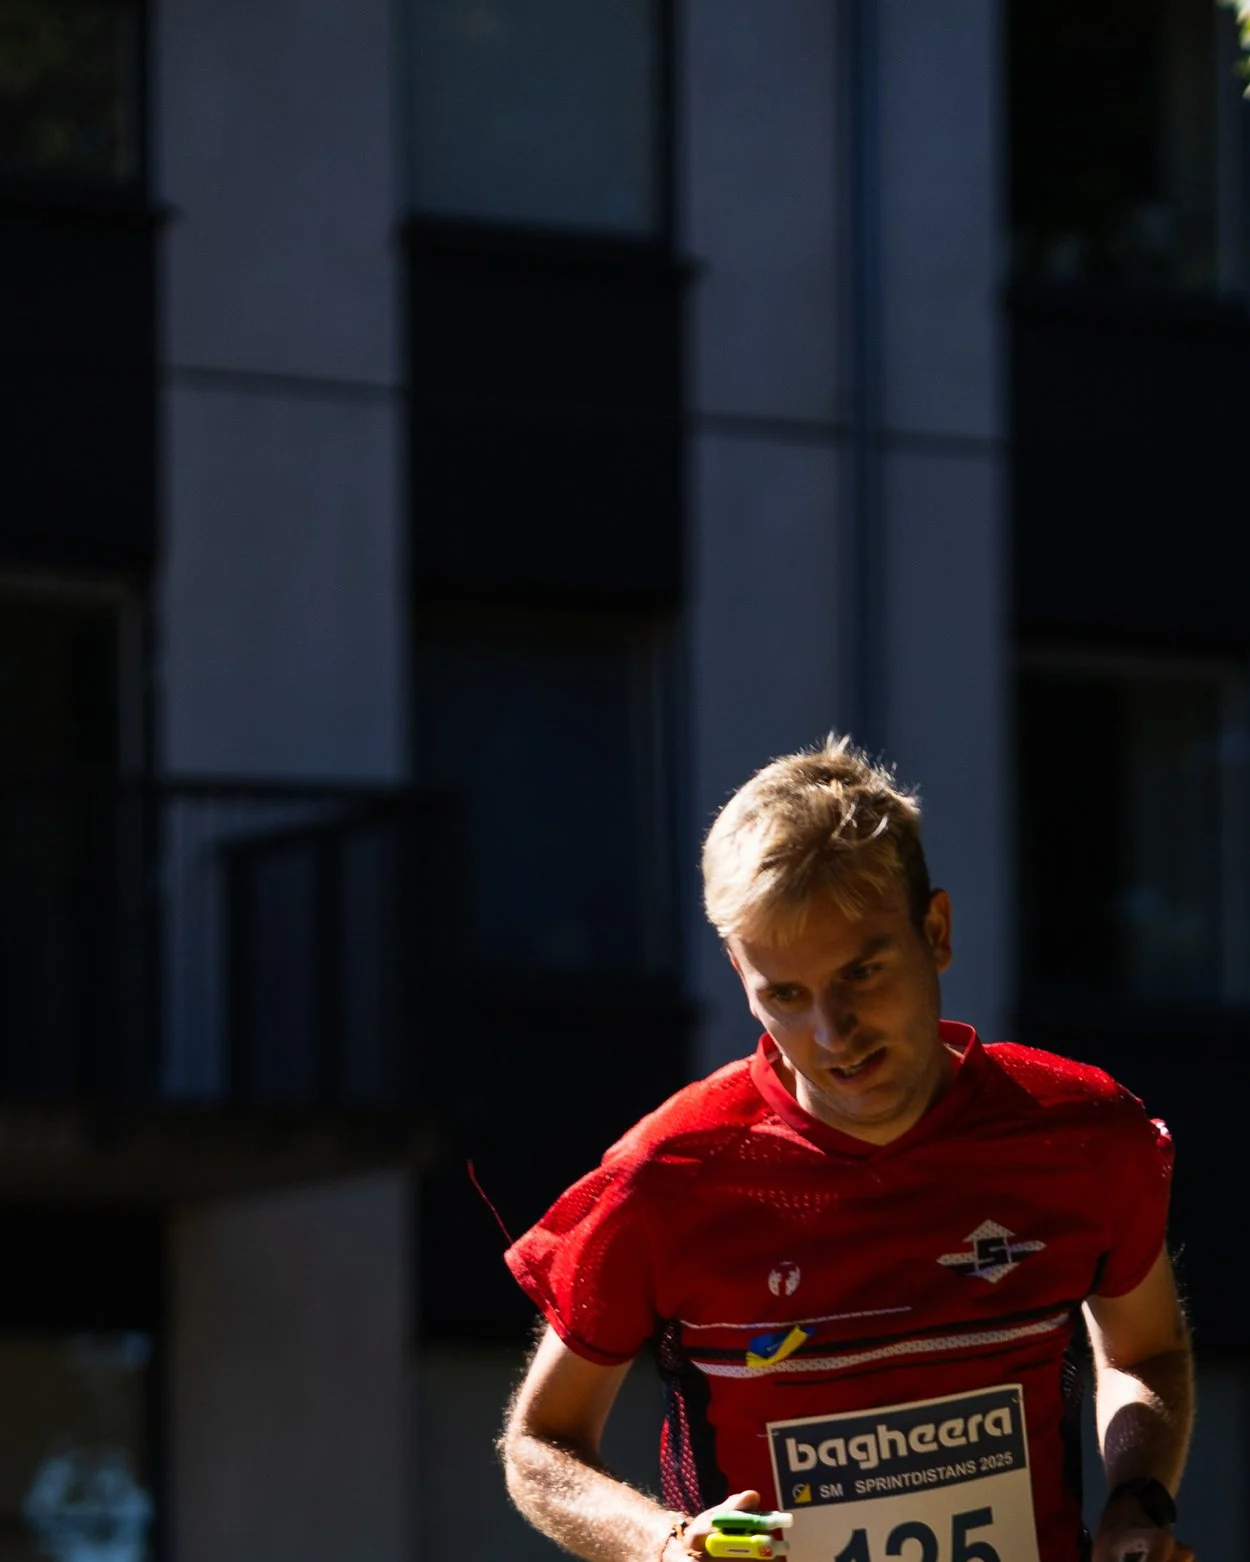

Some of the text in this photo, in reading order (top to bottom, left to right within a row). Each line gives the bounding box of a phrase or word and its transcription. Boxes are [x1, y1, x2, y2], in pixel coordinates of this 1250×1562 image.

[785, 1406, 1013, 1473] bagheera
[820, 1451, 1014, 1499] SM SPRINTDISTANS 2025
